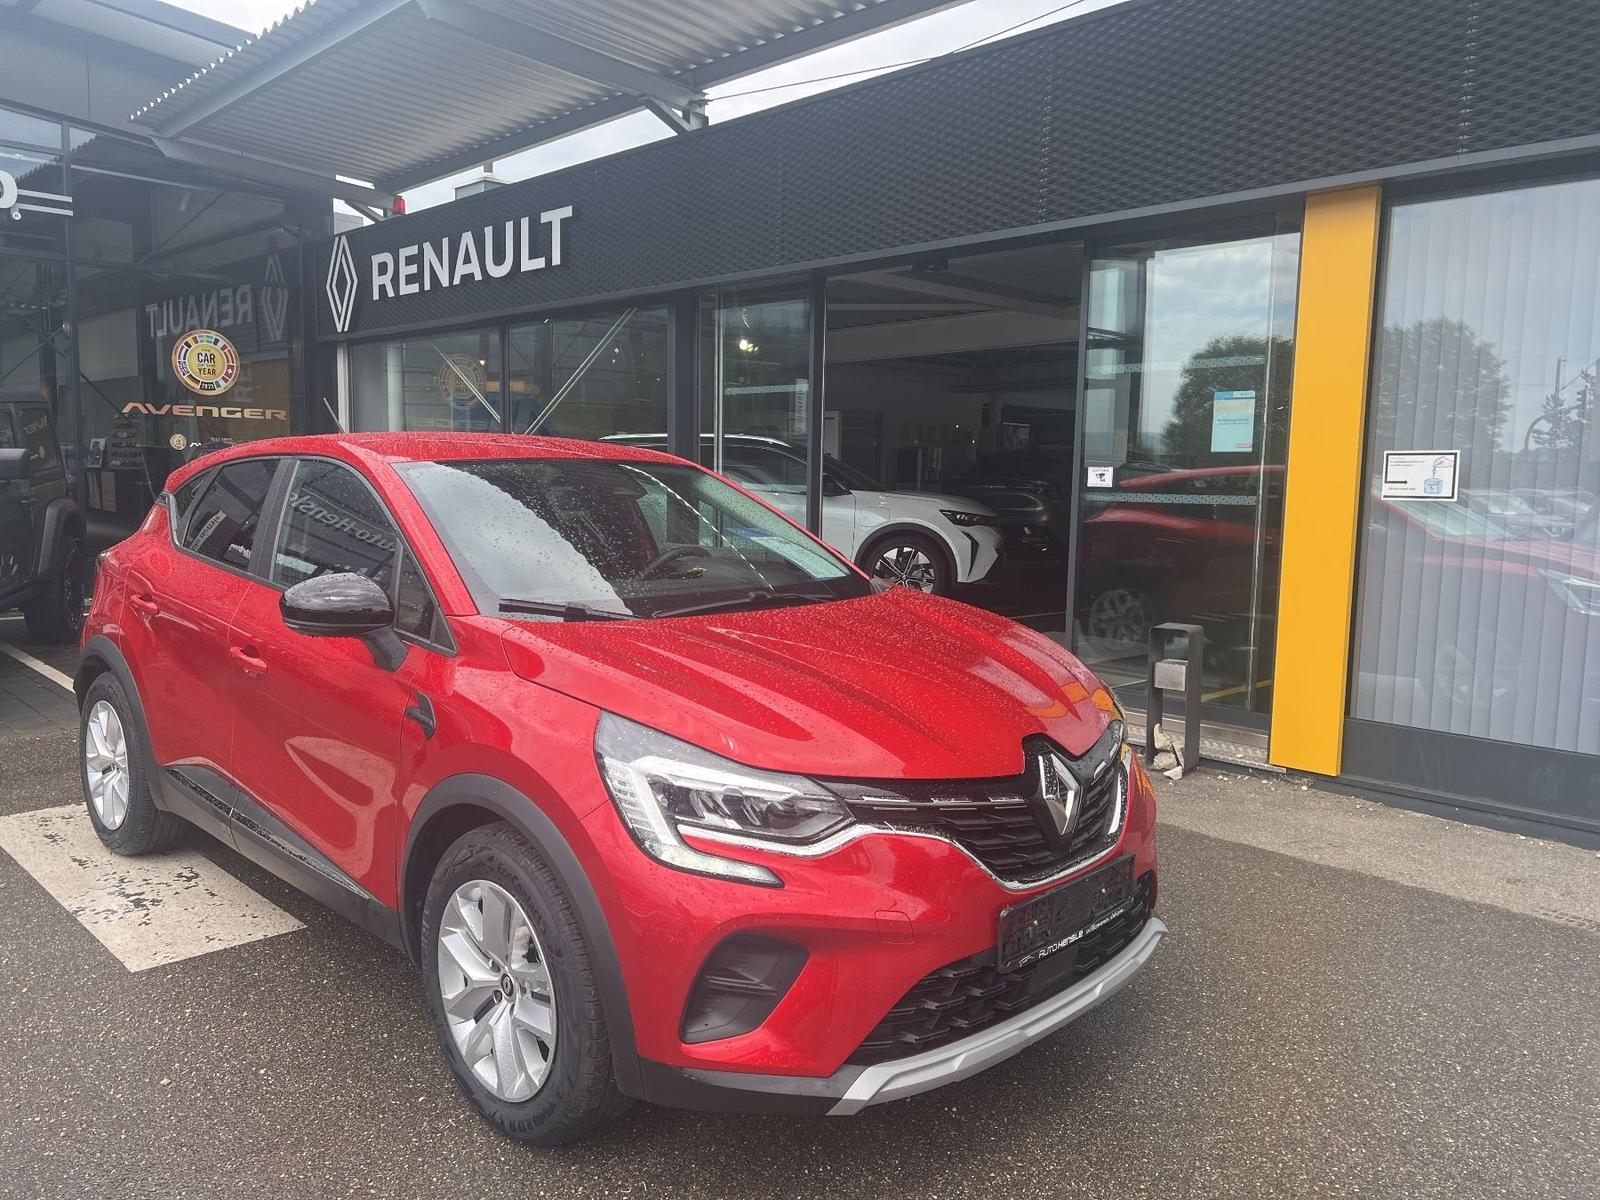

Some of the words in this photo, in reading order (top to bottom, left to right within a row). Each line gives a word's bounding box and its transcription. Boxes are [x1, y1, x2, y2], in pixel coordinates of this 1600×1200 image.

[371, 205, 573, 301] RENAULT
[197, 352, 216, 363] CAR
[197, 367, 217, 376] YEAR
[121, 402, 288, 421] AVENGER
